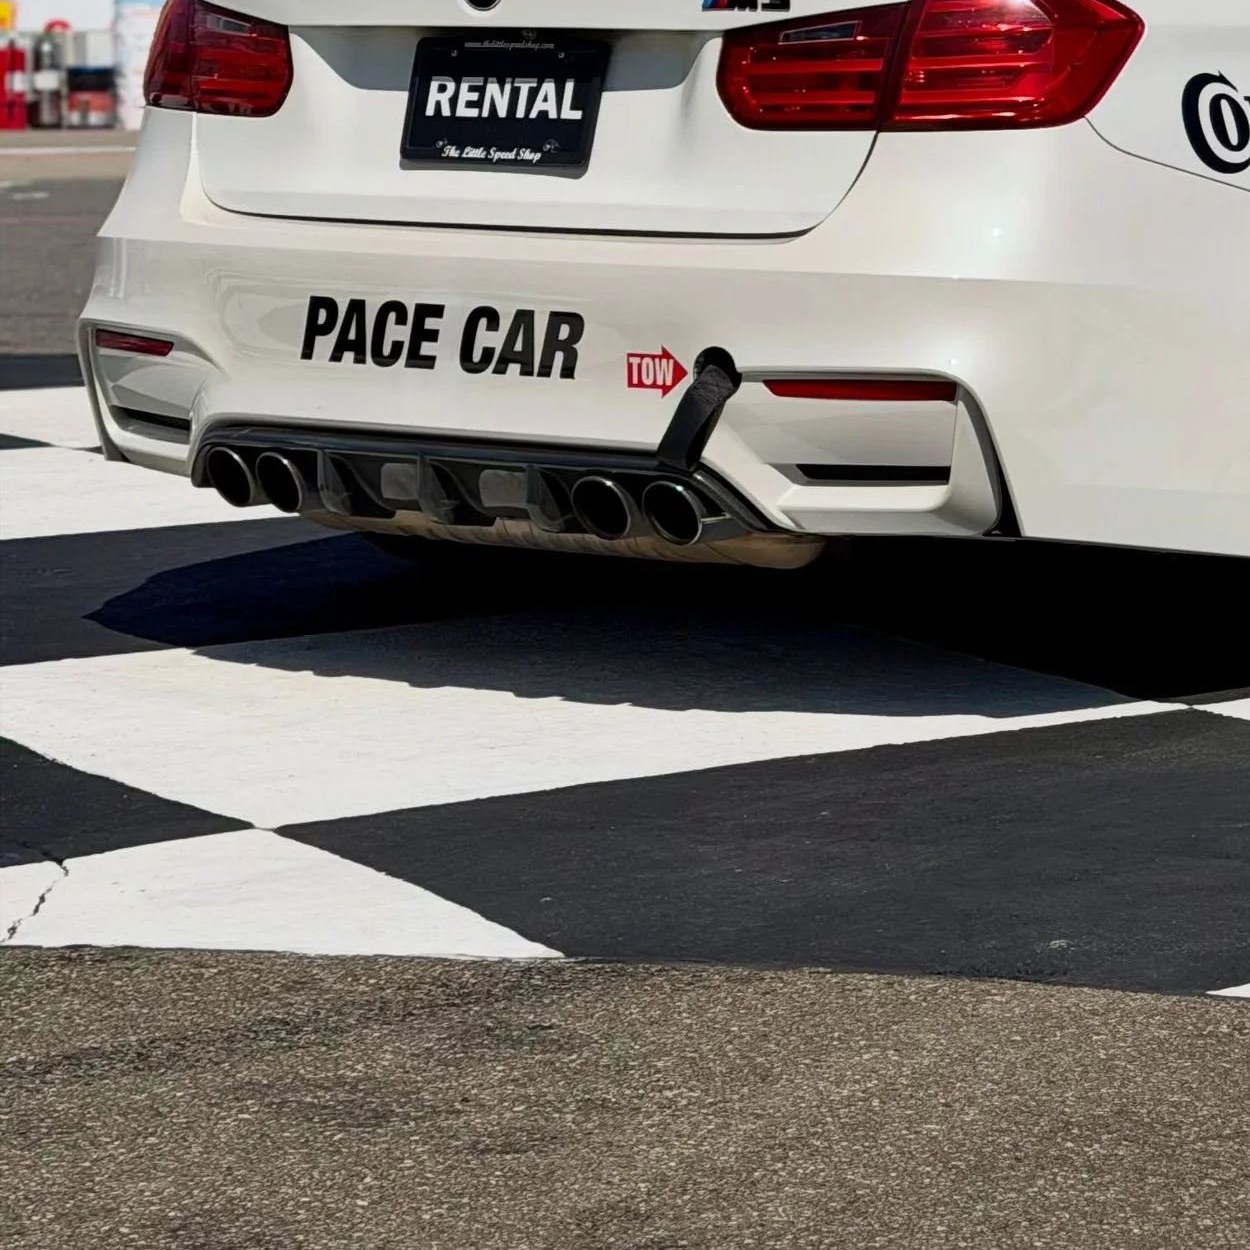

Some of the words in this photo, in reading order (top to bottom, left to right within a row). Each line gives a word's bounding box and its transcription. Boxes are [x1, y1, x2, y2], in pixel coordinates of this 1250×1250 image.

[425, 76, 583, 120] RENTAL
[441, 146, 460, 159] The
[461, 146, 486, 159] Little
[489, 148, 516, 162] Speed
[517, 149, 542, 163] Shop
[300, 295, 446, 370] PACE
[459, 305, 585, 380] CAR
[629, 356, 676, 386] TOW
